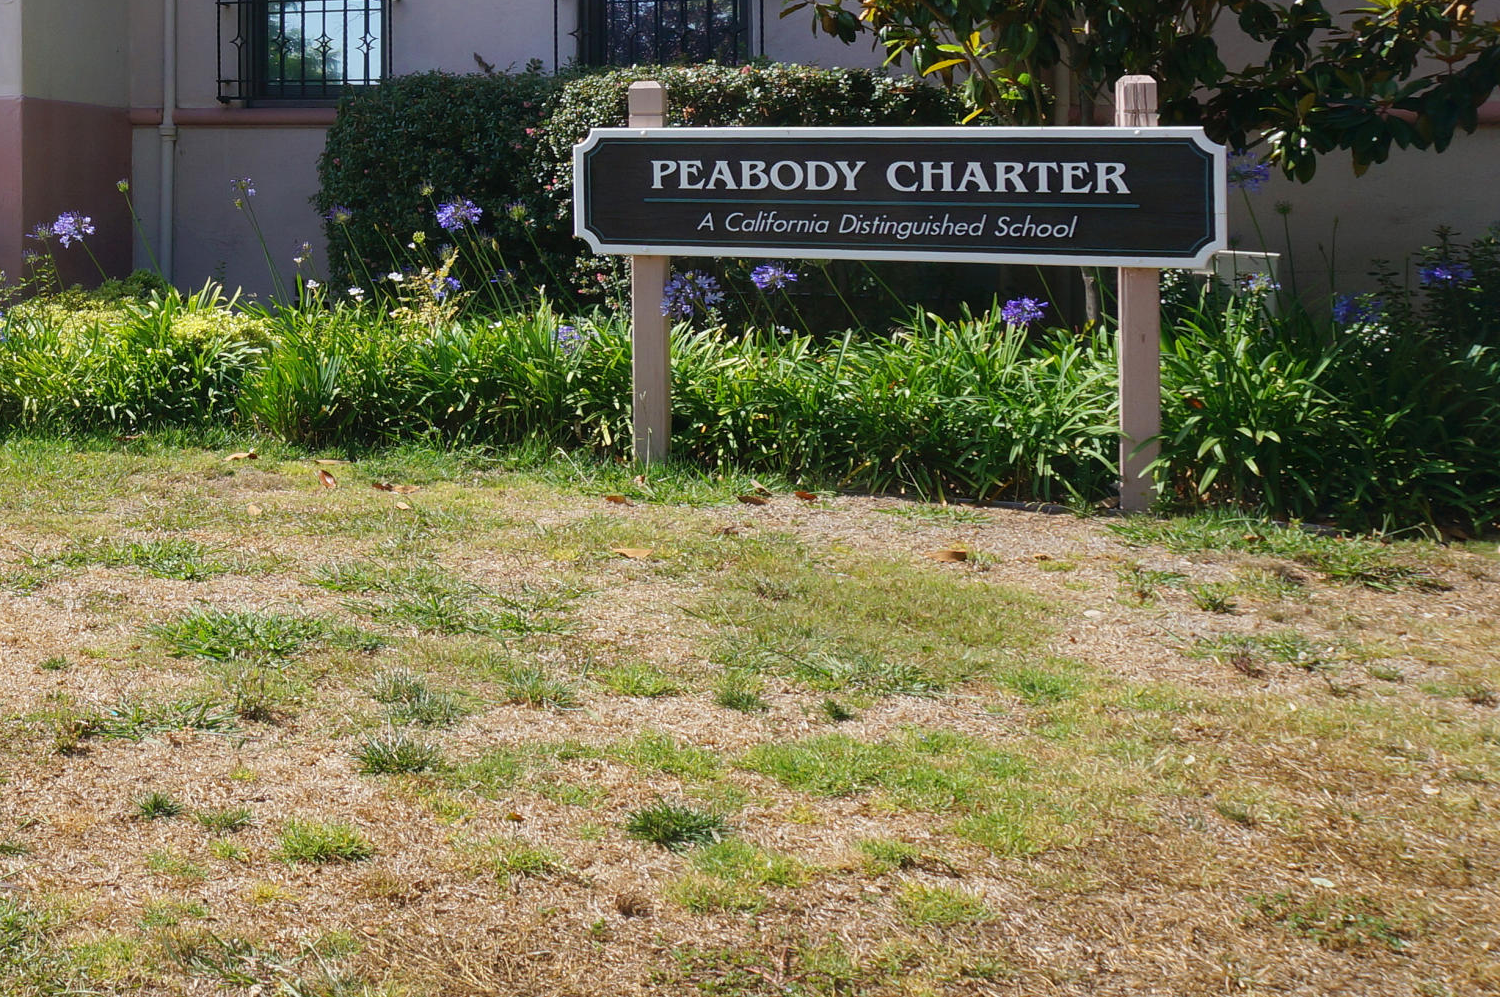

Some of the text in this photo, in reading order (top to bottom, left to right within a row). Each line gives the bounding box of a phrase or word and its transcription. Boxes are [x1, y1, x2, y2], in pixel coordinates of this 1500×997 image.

[650, 160, 1130, 194] PEABODY CHARTER
[697, 212, 1078, 239] A California Distinguished School
